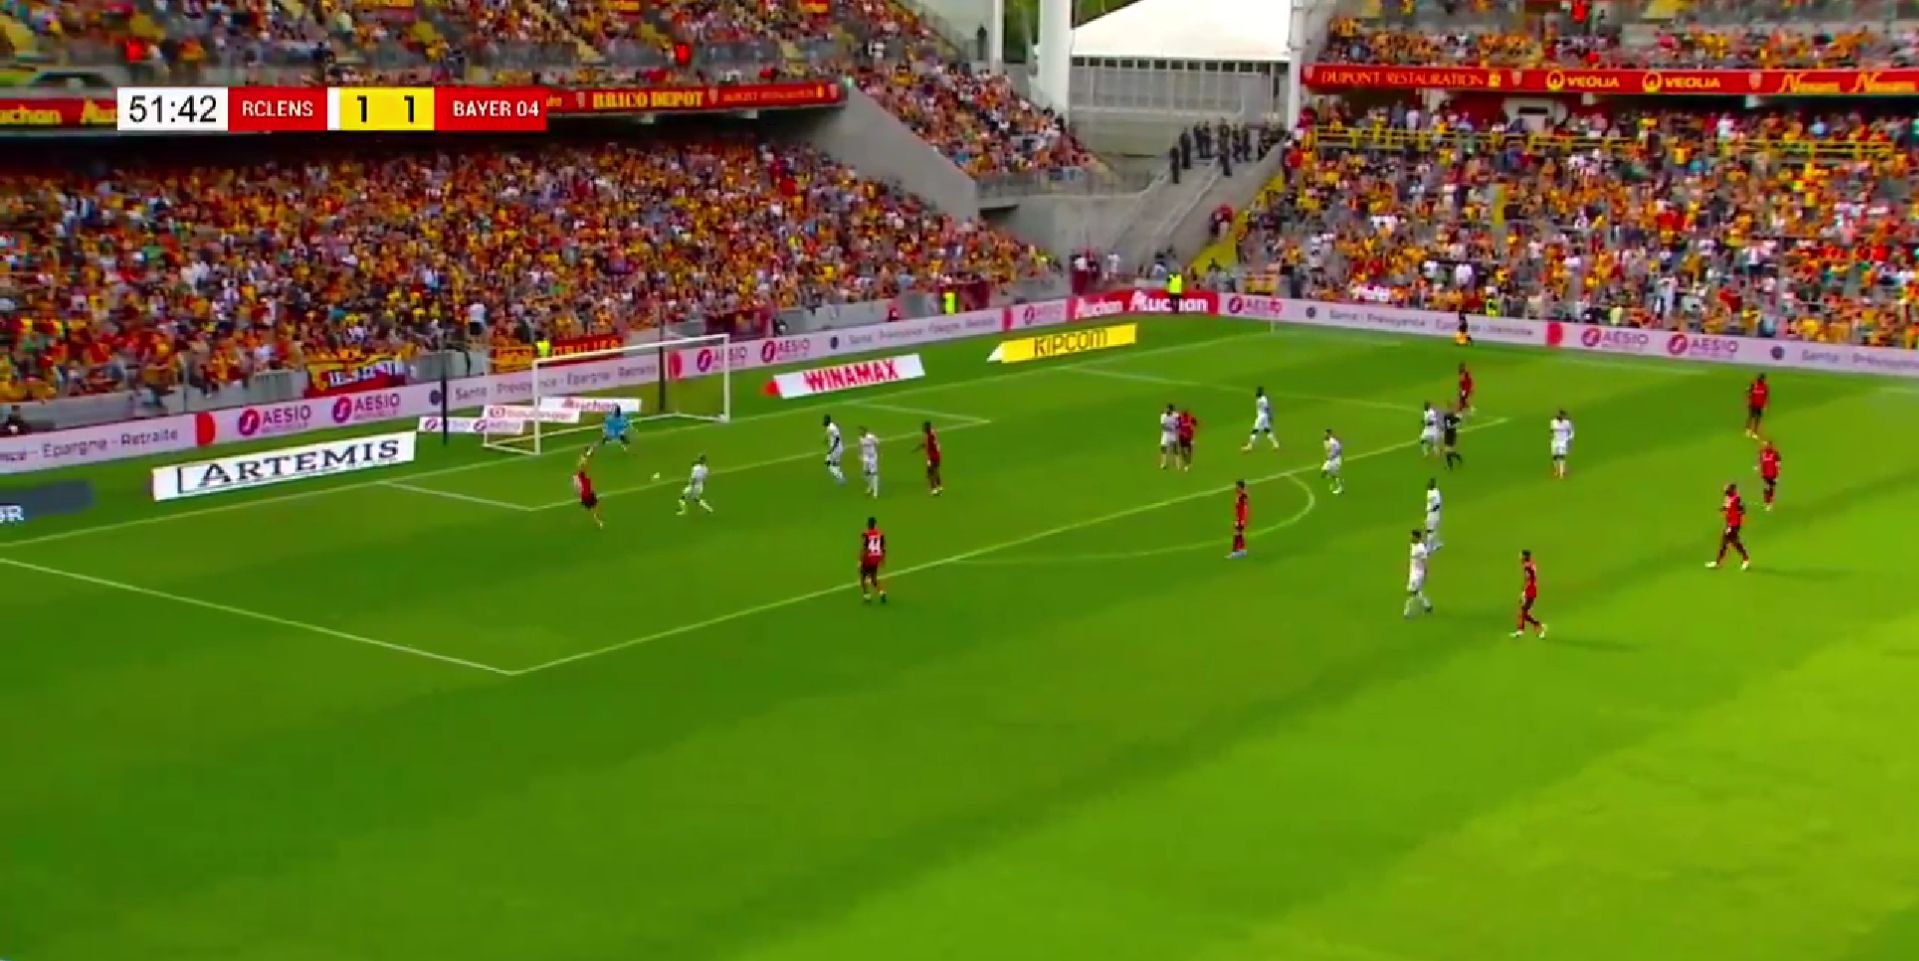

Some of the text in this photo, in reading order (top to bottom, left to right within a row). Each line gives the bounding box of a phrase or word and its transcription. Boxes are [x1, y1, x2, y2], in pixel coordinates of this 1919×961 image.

[1321, 71, 1380, 85] DUPONT
[1567, 76, 1621, 88] VEOLIA
[1664, 76, 1721, 89] VEOLIA
[804, 359, 899, 391] WINAMAX
[354, 392, 401, 413] AESIO
[262, 404, 312, 425] AESIO
[199, 439, 400, 488] ARTEMIS
